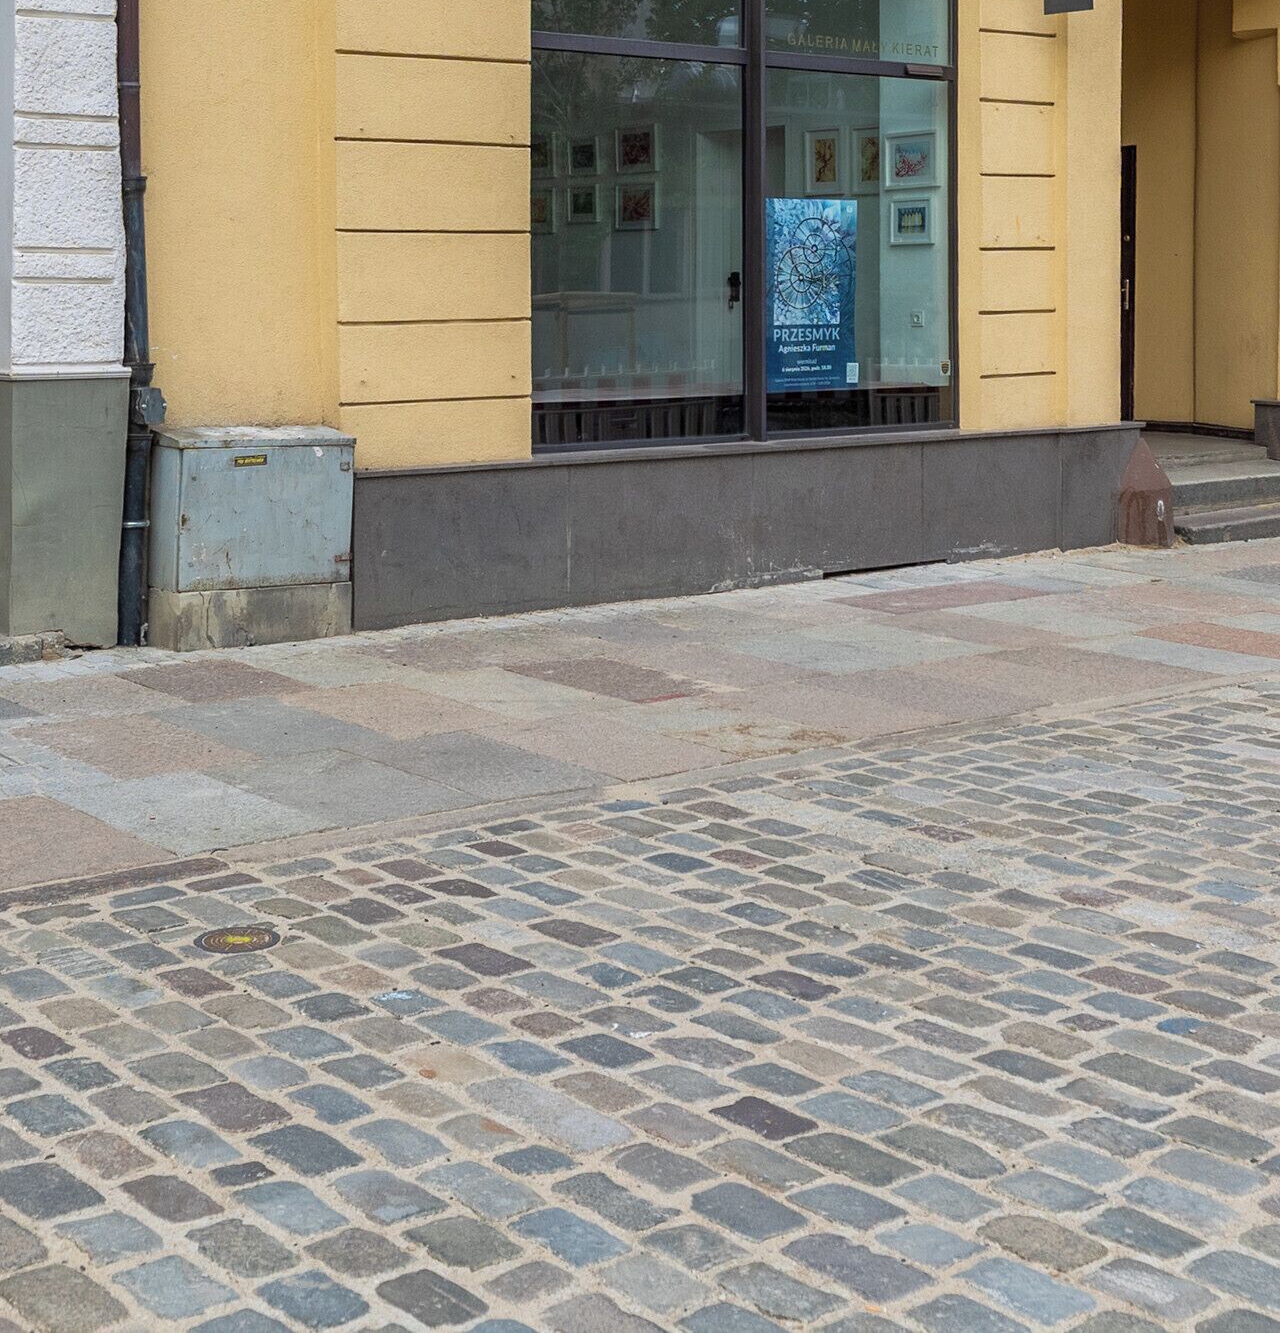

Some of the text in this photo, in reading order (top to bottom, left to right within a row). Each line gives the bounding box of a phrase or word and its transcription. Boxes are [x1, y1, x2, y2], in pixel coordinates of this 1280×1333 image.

[787, 33, 938, 58] GALERIA MAŁY KIERAT
[773, 327, 840, 342] PRZESMYK
[778, 344, 836, 354] Agnieszka Furman
